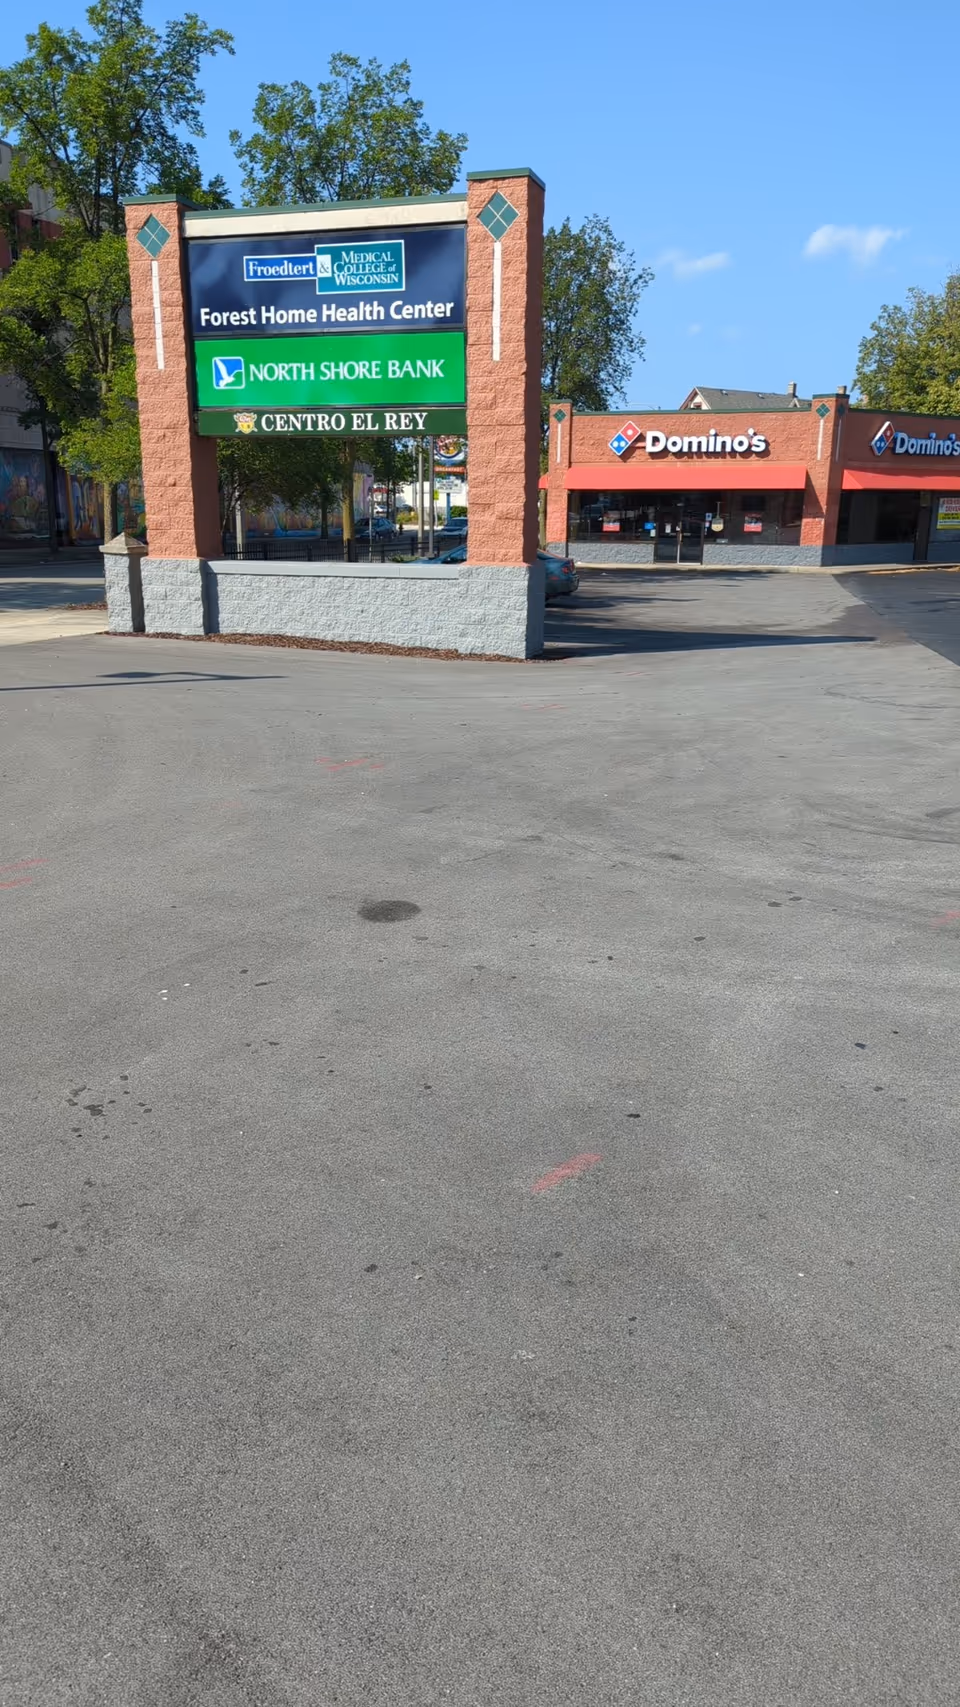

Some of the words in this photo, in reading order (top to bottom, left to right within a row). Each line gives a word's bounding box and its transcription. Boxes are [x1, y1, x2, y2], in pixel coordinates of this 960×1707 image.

[341, 250, 394, 262] MEDICAL
[248, 260, 315, 276] Froedtert
[319, 262, 330, 274] &
[334, 262, 387, 274] COLLEGE
[388, 263, 396, 272] of
[334, 272, 398, 286] WISCONSIN
[200, 308, 256, 326] Forest
[262, 306, 317, 324] Home
[322, 301, 384, 322] Health
[390, 300, 454, 320] Center
[250, 362, 314, 382] NORTH
[320, 360, 382, 380] SHORE
[388, 359, 445, 378] BANK
[261, 414, 345, 432] CENTRO
[351, 413, 379, 430] EL
[384, 412, 428, 430] REY
[645, 428, 767, 454] Domino's
[895, 432, 960, 456] Domino's
